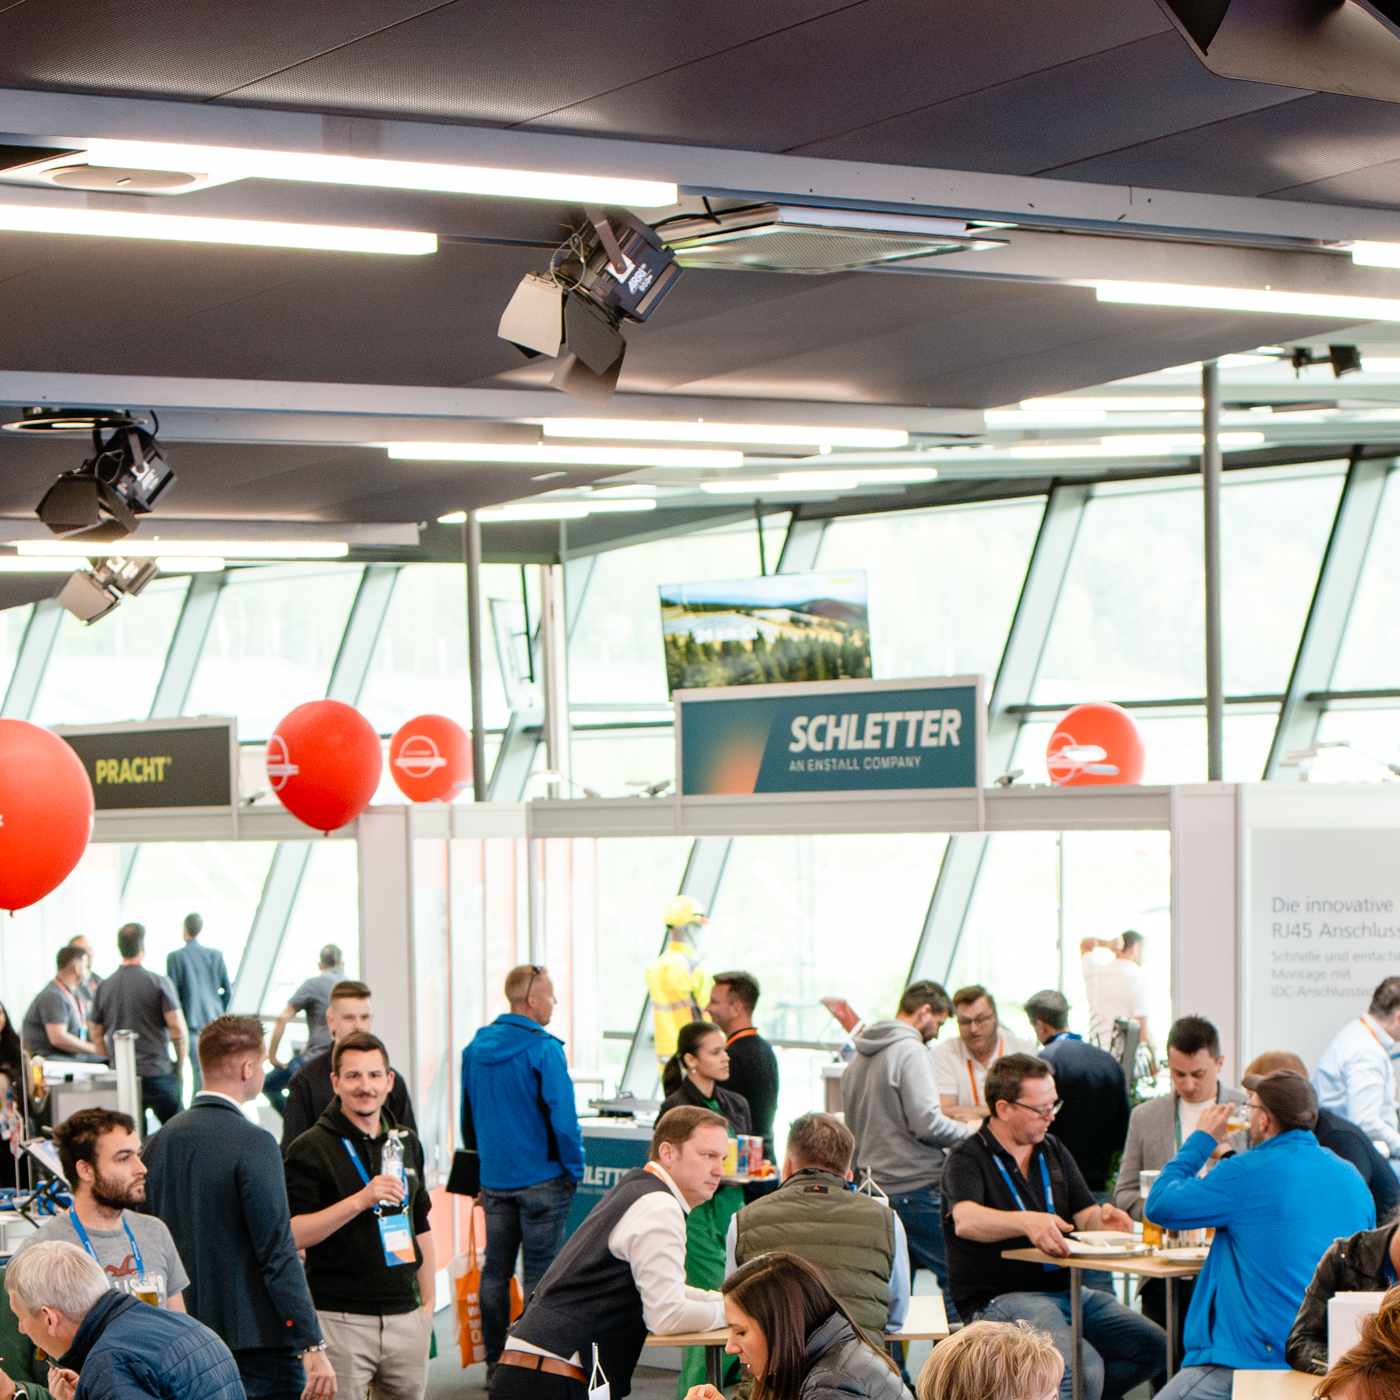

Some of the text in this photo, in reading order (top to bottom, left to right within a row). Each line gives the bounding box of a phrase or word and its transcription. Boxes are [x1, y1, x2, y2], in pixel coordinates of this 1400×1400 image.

[789, 708, 962, 753] SCHLETTER
[95, 757, 165, 784] PRACHT
[789, 756, 921, 772] AN ENSTALL COMPANY
[1272, 896, 1394, 913] Die innovative
[1272, 922, 1313, 939] RJ45
[1271, 951, 1321, 963] Schnelle
[1325, 951, 1350, 962] und
[1272, 968, 1351, 982] Montage mit
[1272, 984, 1374, 998] IDC-Anschlusstec
